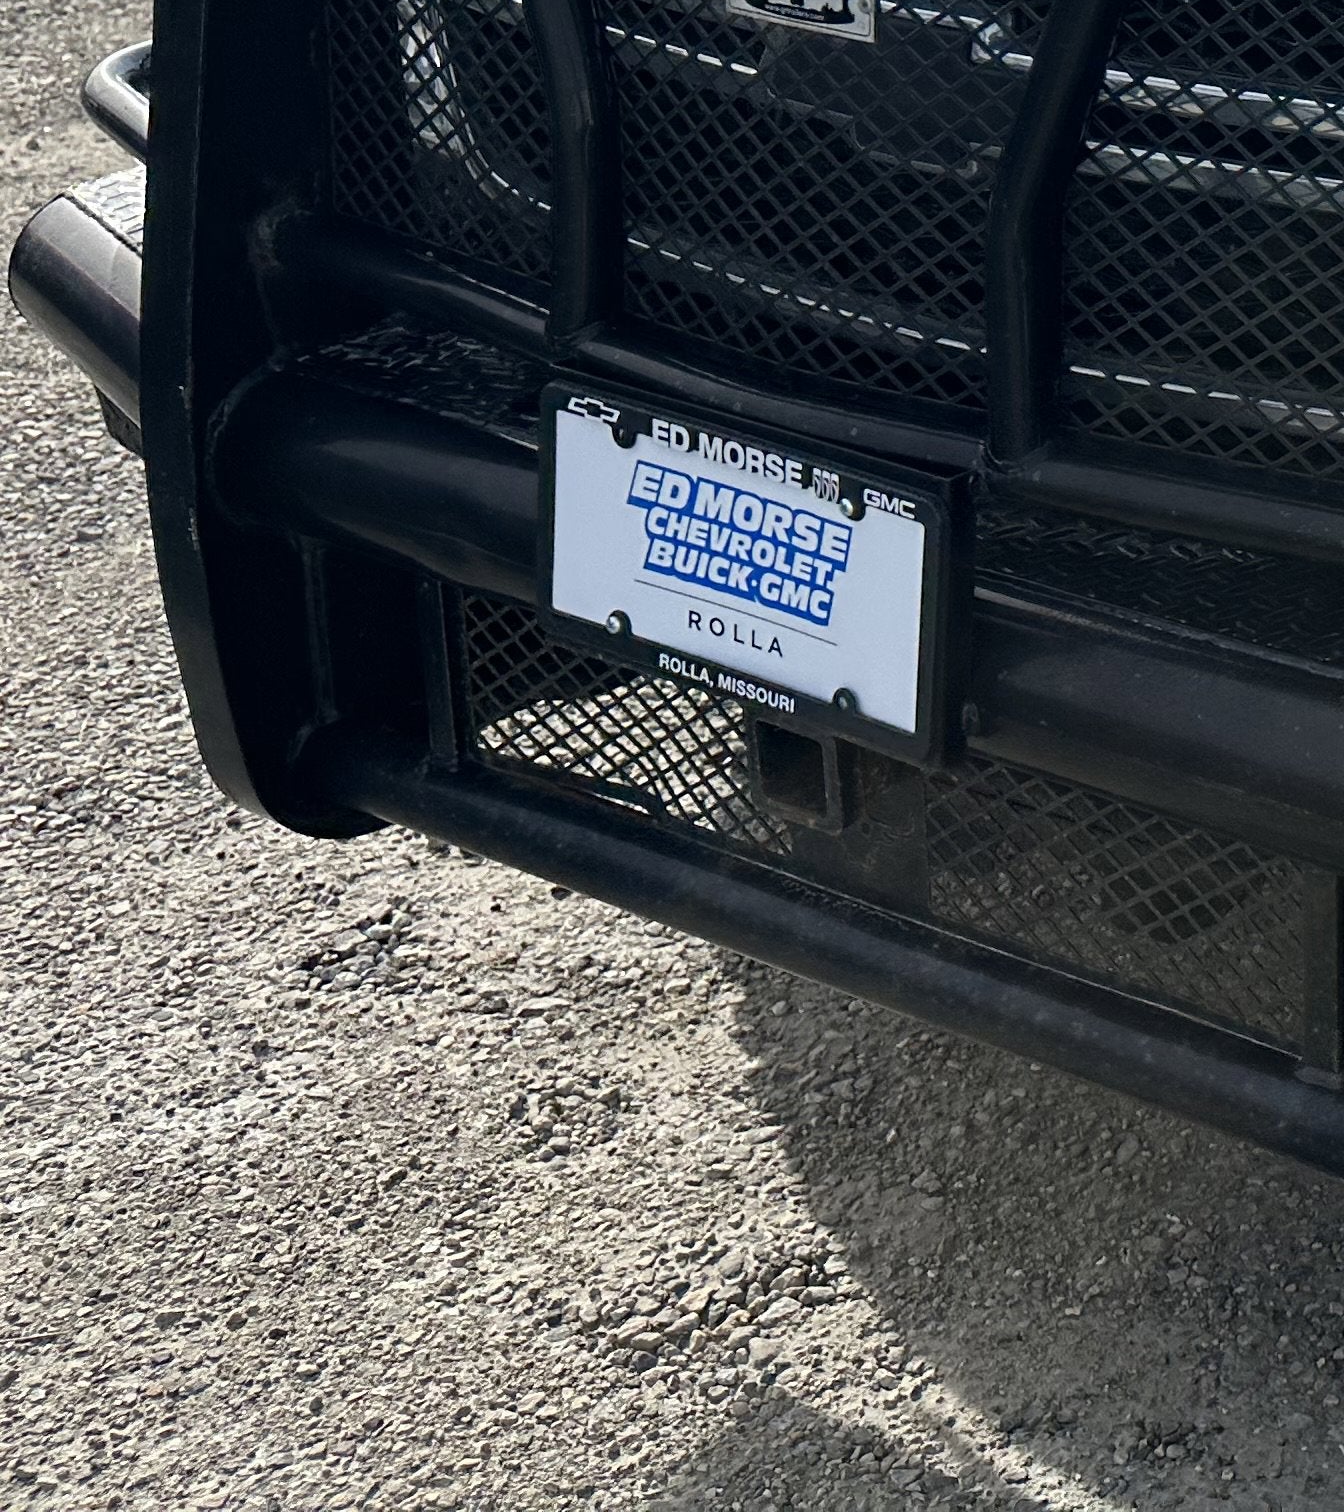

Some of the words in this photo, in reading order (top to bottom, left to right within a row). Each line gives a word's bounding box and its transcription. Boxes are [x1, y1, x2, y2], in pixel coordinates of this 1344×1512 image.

[651, 418, 690, 453] ED
[698, 432, 803, 489] MORSE
[863, 488, 916, 519] GMC
[631, 465, 691, 509] ED
[697, 482, 849, 562] MORSE
[646, 510, 832, 589] CHEVROLET
[687, 610, 783, 658] ROLLA
[659, 653, 714, 688] ROLLA,
[717, 672, 796, 714] MISSOURI
